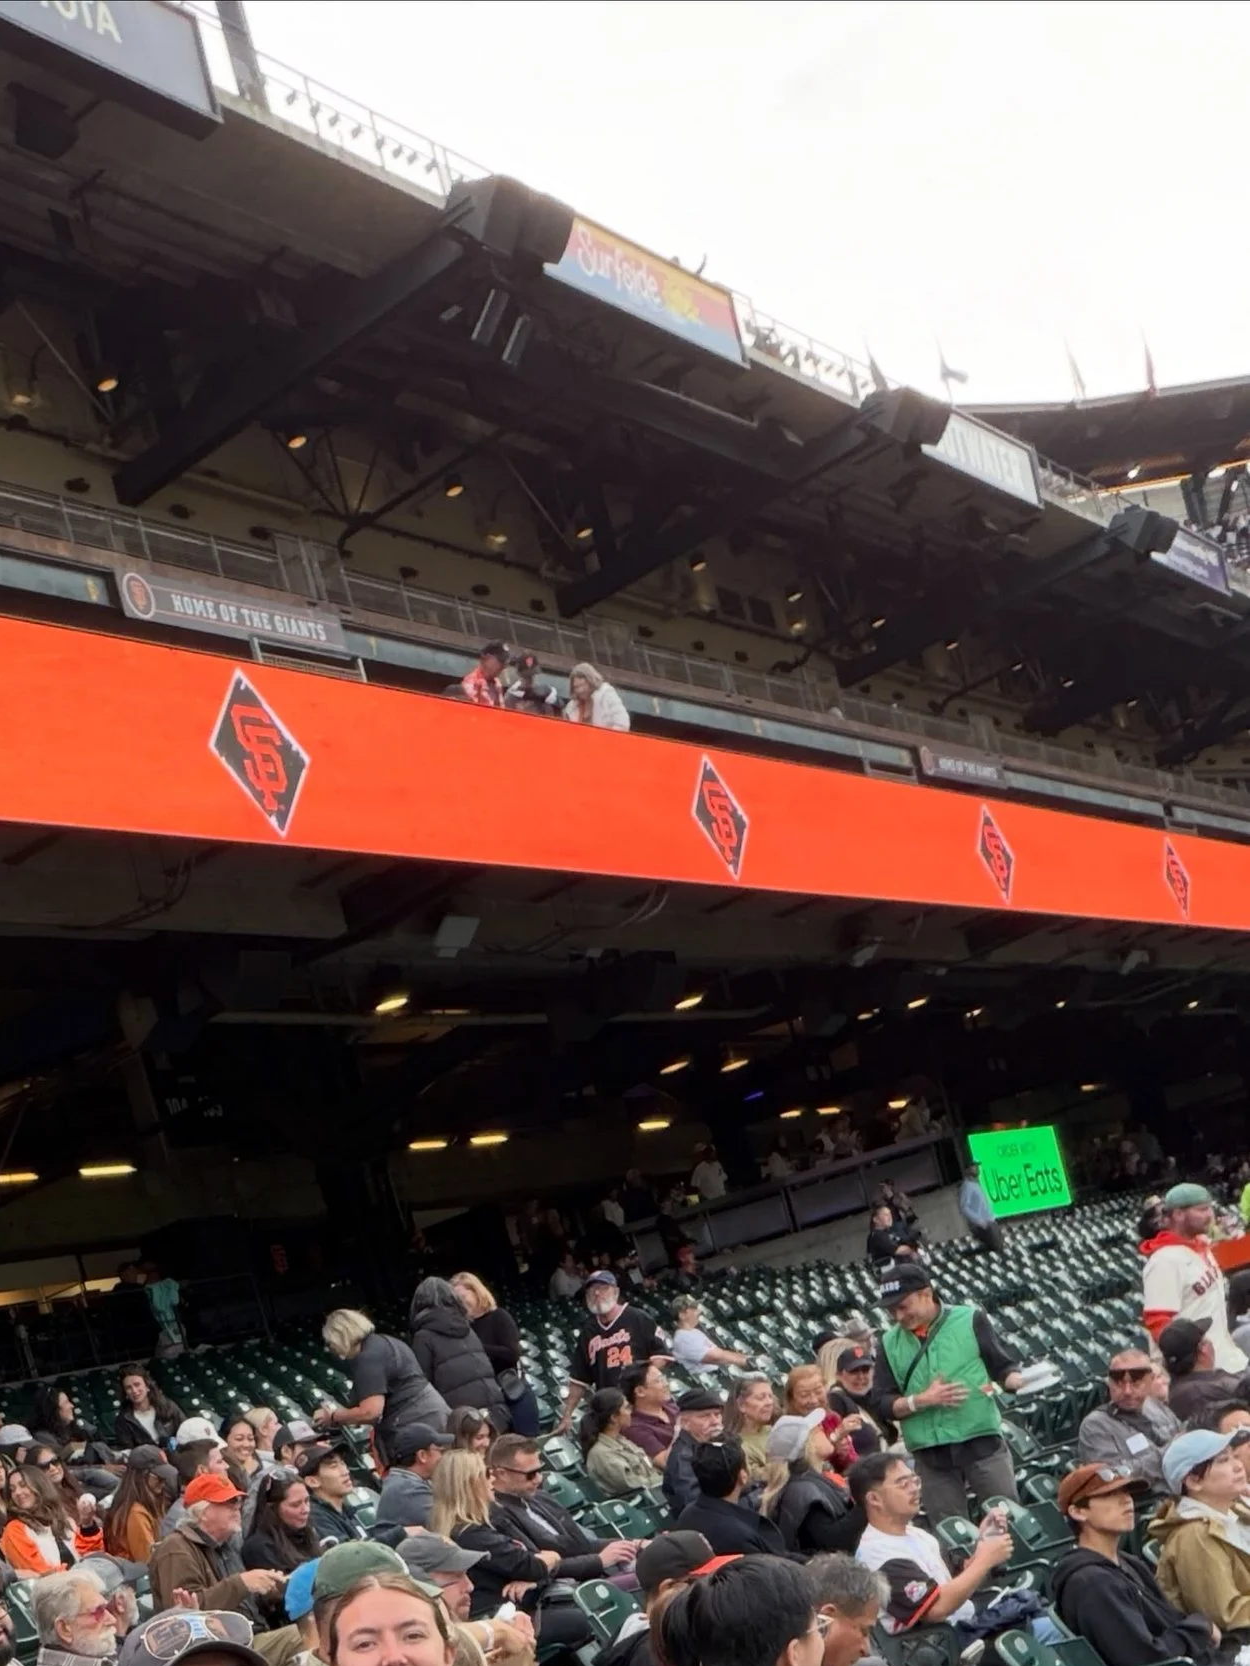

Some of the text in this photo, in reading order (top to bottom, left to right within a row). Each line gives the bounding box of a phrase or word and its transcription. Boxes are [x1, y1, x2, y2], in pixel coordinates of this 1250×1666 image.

[577, 223, 659, 294] Surfside
[171, 594, 327, 641] HOME OF THE GIANTS
[230, 704, 288, 811] SF
[983, 1162, 1063, 1203] Uber Eats
[607, 1345, 633, 1368] 24
